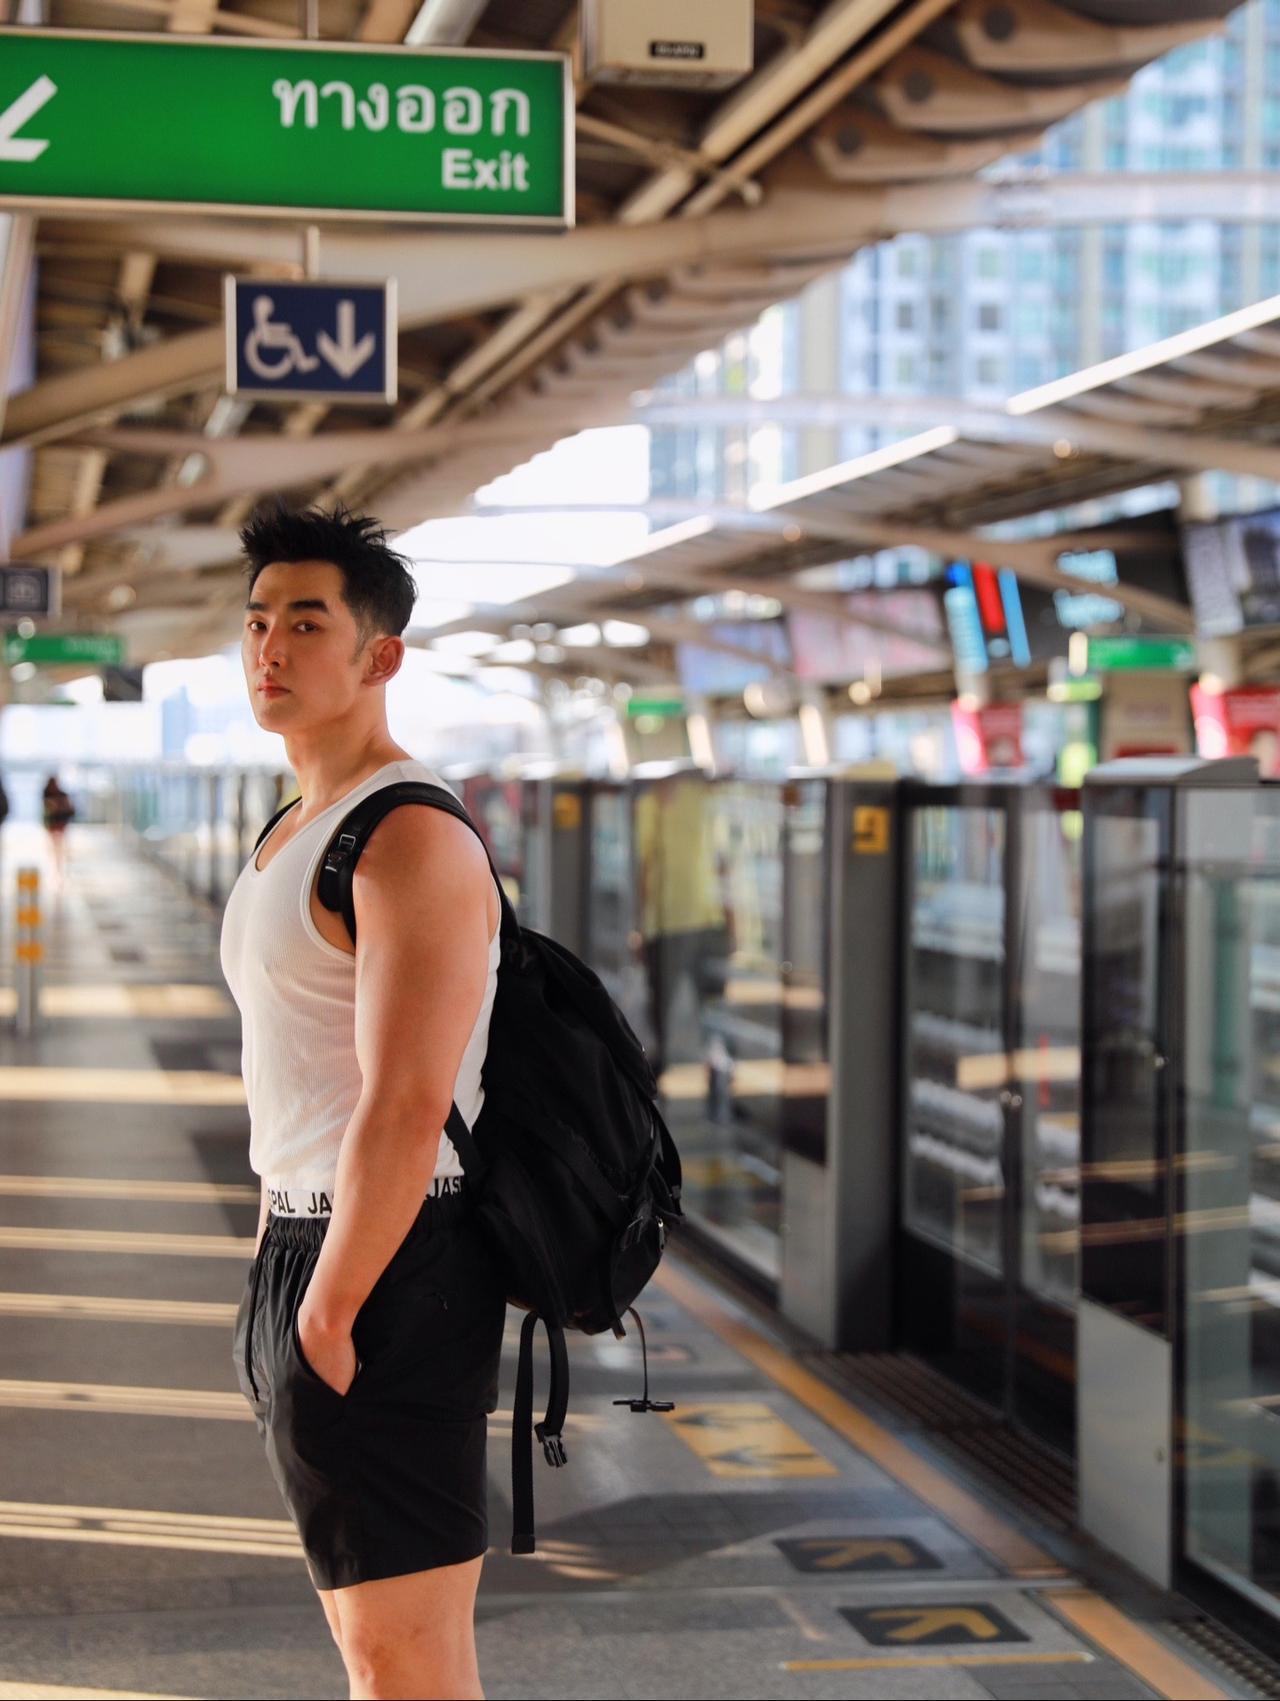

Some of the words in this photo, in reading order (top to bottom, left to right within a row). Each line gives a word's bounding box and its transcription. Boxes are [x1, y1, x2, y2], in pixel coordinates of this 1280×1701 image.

[272, 78, 531, 137] ทางออก
[441, 147, 530, 192] Exit
[307, 1191, 334, 1215] JA
